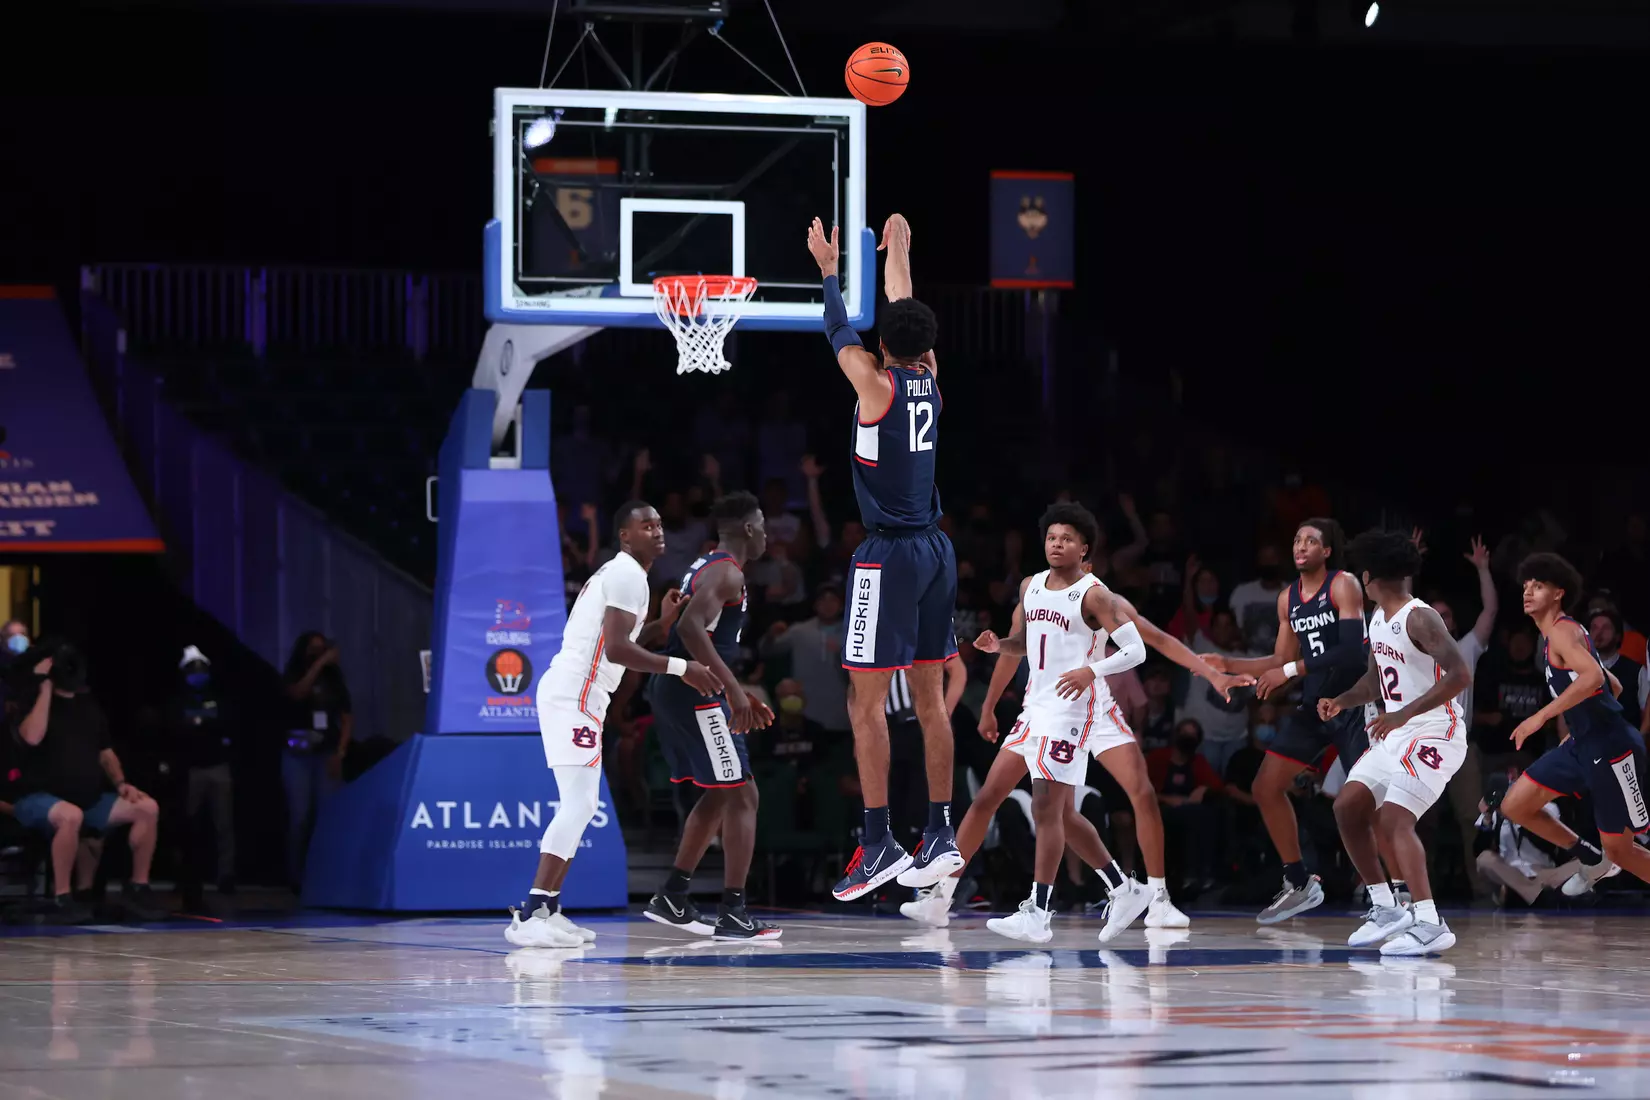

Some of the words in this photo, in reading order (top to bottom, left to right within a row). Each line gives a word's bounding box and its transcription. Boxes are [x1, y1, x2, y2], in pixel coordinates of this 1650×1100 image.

[907, 401, 933, 452] 12
[853, 578, 871, 658] HUSKIES
[1290, 610, 1336, 633] UCONN
[1039, 634, 1047, 670] 1
[1307, 631, 1325, 657] 5
[1372, 641, 1406, 664] UBURN
[478, 705, 539, 717] ATLANTI
[707, 714, 734, 779] HUSKIES
[1622, 763, 1648, 822] HUSKIES
[411, 801, 609, 829] ATLANTS
[427, 839, 484, 849] PARADISE
[489, 839, 532, 849] ISLAND
